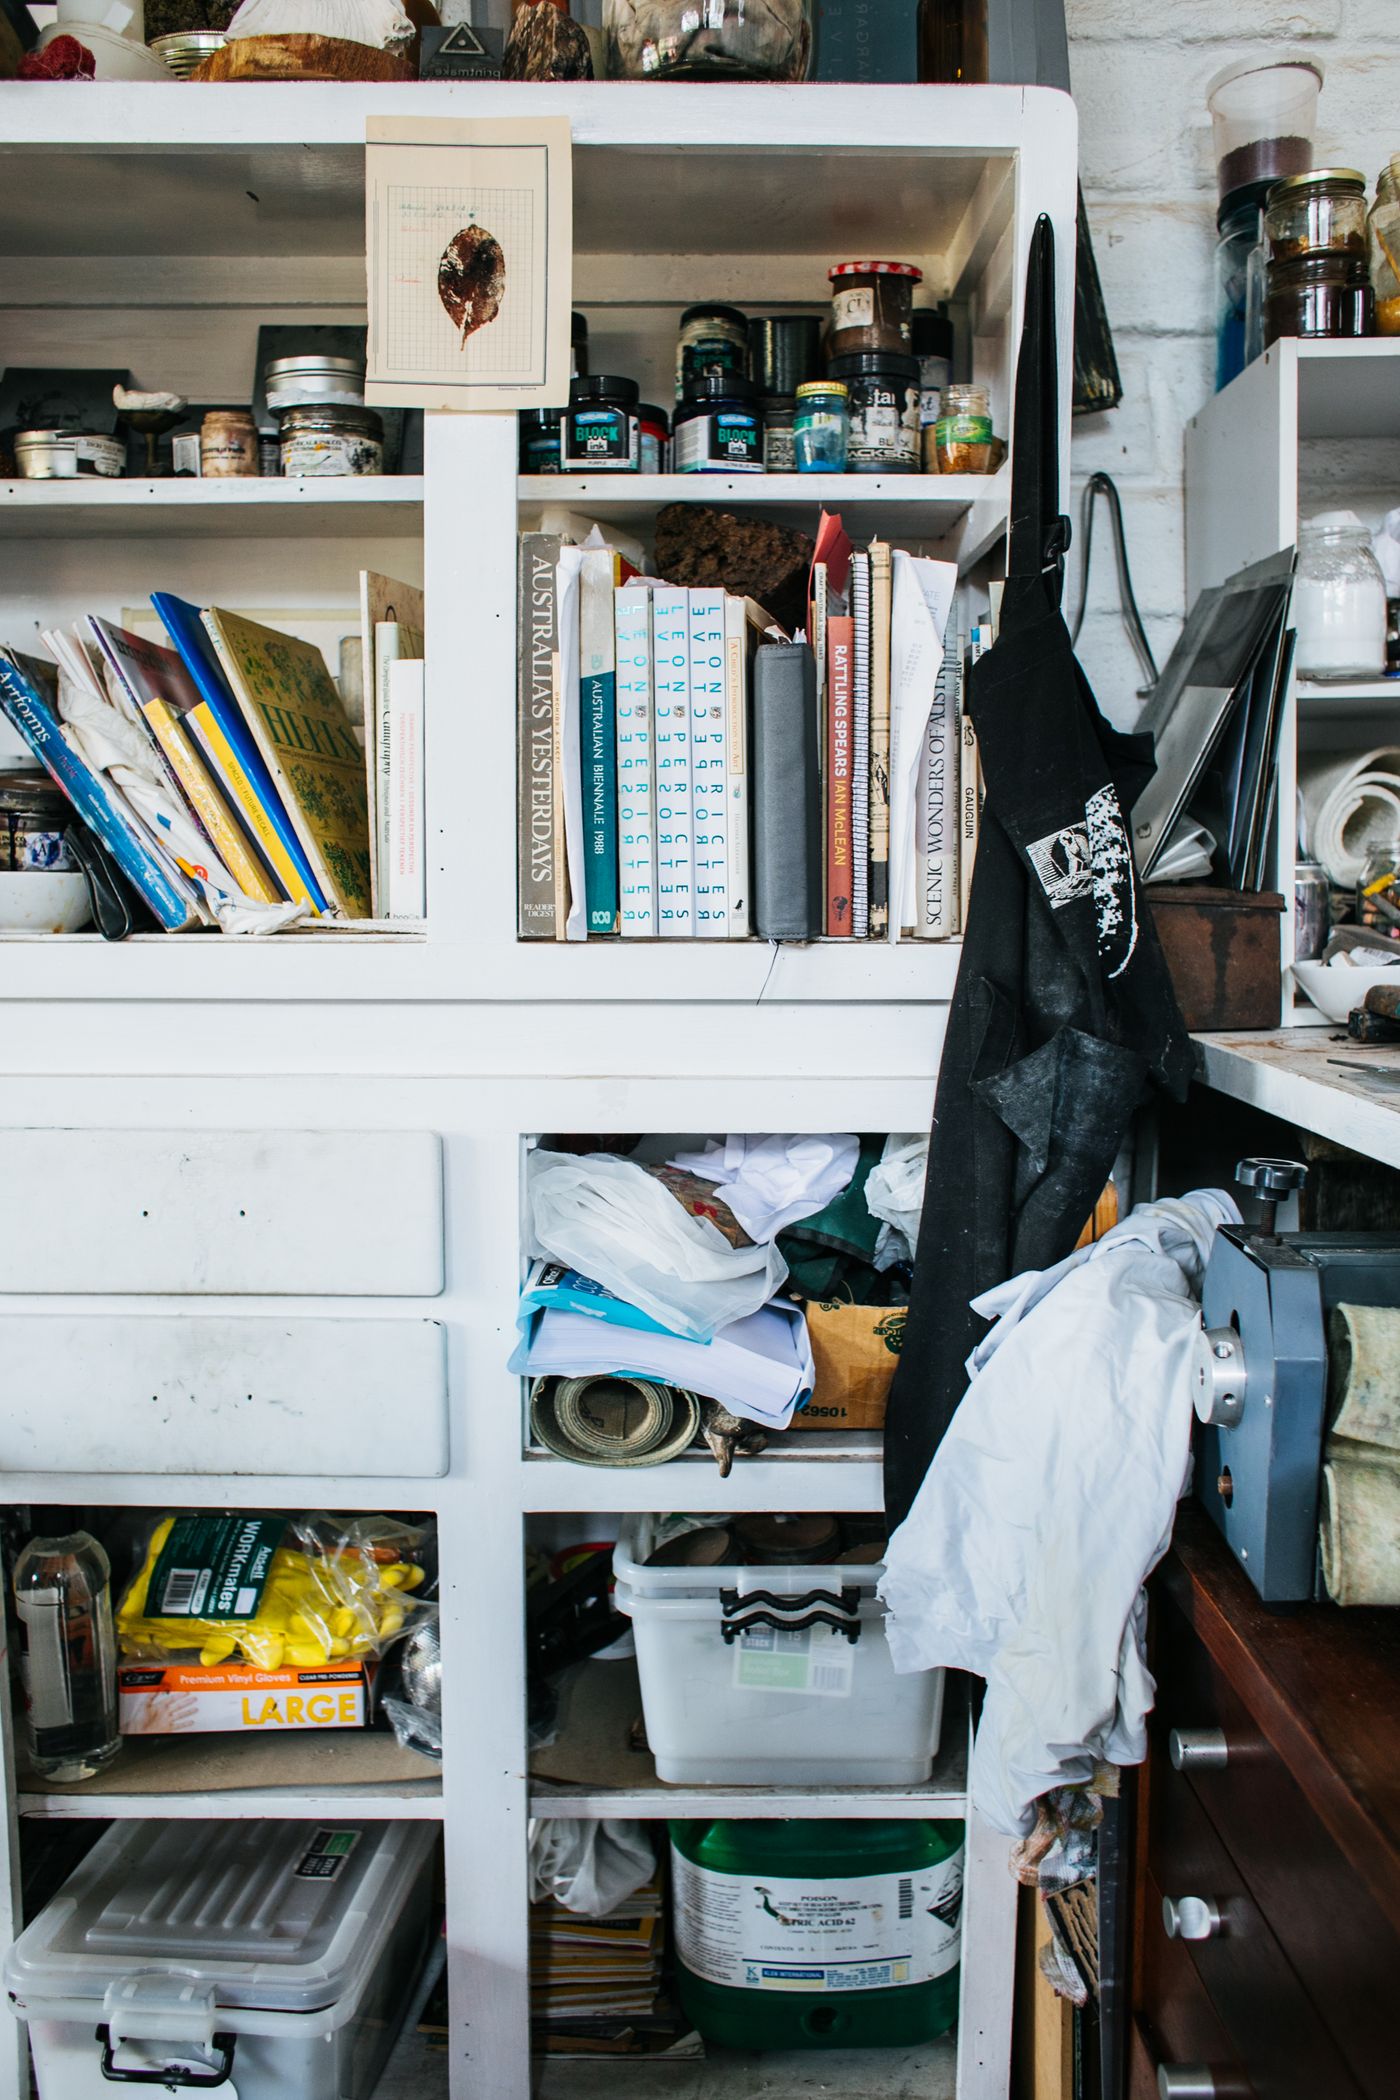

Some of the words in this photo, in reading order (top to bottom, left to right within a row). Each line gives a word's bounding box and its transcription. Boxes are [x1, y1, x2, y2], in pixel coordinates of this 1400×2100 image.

[576, 427, 618, 441] BLOCK
[589, 442, 605, 451] ink
[718, 428, 757, 445] BLOCK
[731, 444, 745, 453] ink
[531, 555, 553, 719] AUSTRALIA'S
[633, 606, 647, 692] LEON
[671, 605, 686, 692] LEON
[708, 606, 722, 693] LEON
[0, 672, 51, 743] Artforms
[834, 645, 848, 717] RATTLING
[592, 680, 604, 759] AUSTRALIAN
[929, 730, 945, 755] OF
[834, 720, 848, 777] SPEARS
[242, 790, 258, 815] FUTURE
[256, 813, 271, 838] RECALL
[531, 729, 553, 883] YESTERDAYS
[593, 764, 604, 825] BIENNALE
[834, 780, 847, 804] IAN
[927, 757, 945, 854] WONDERS
[964, 787, 974, 839] GAUGUIN
[594, 831, 605, 855] 1988
[635, 732, 650, 919] PERICLES
[674, 732, 689, 919] PERICLES
[710, 733, 726, 919] PERICLES
[833, 808, 847, 866] McLEAN
[527, 910, 555, 918] DIGEST
[926, 858, 944, 926] SCENIC
[252, 1545, 273, 1580] Ansell
[179, 1672, 225, 1684] Premium
[228, 1672, 253, 1685] Vinyl
[255, 1672, 292, 1684] Gloves
[241, 1693, 357, 1725] LARGE
[818, 1918, 844, 1926] ACID
[844, 1917, 856, 1926] 62
